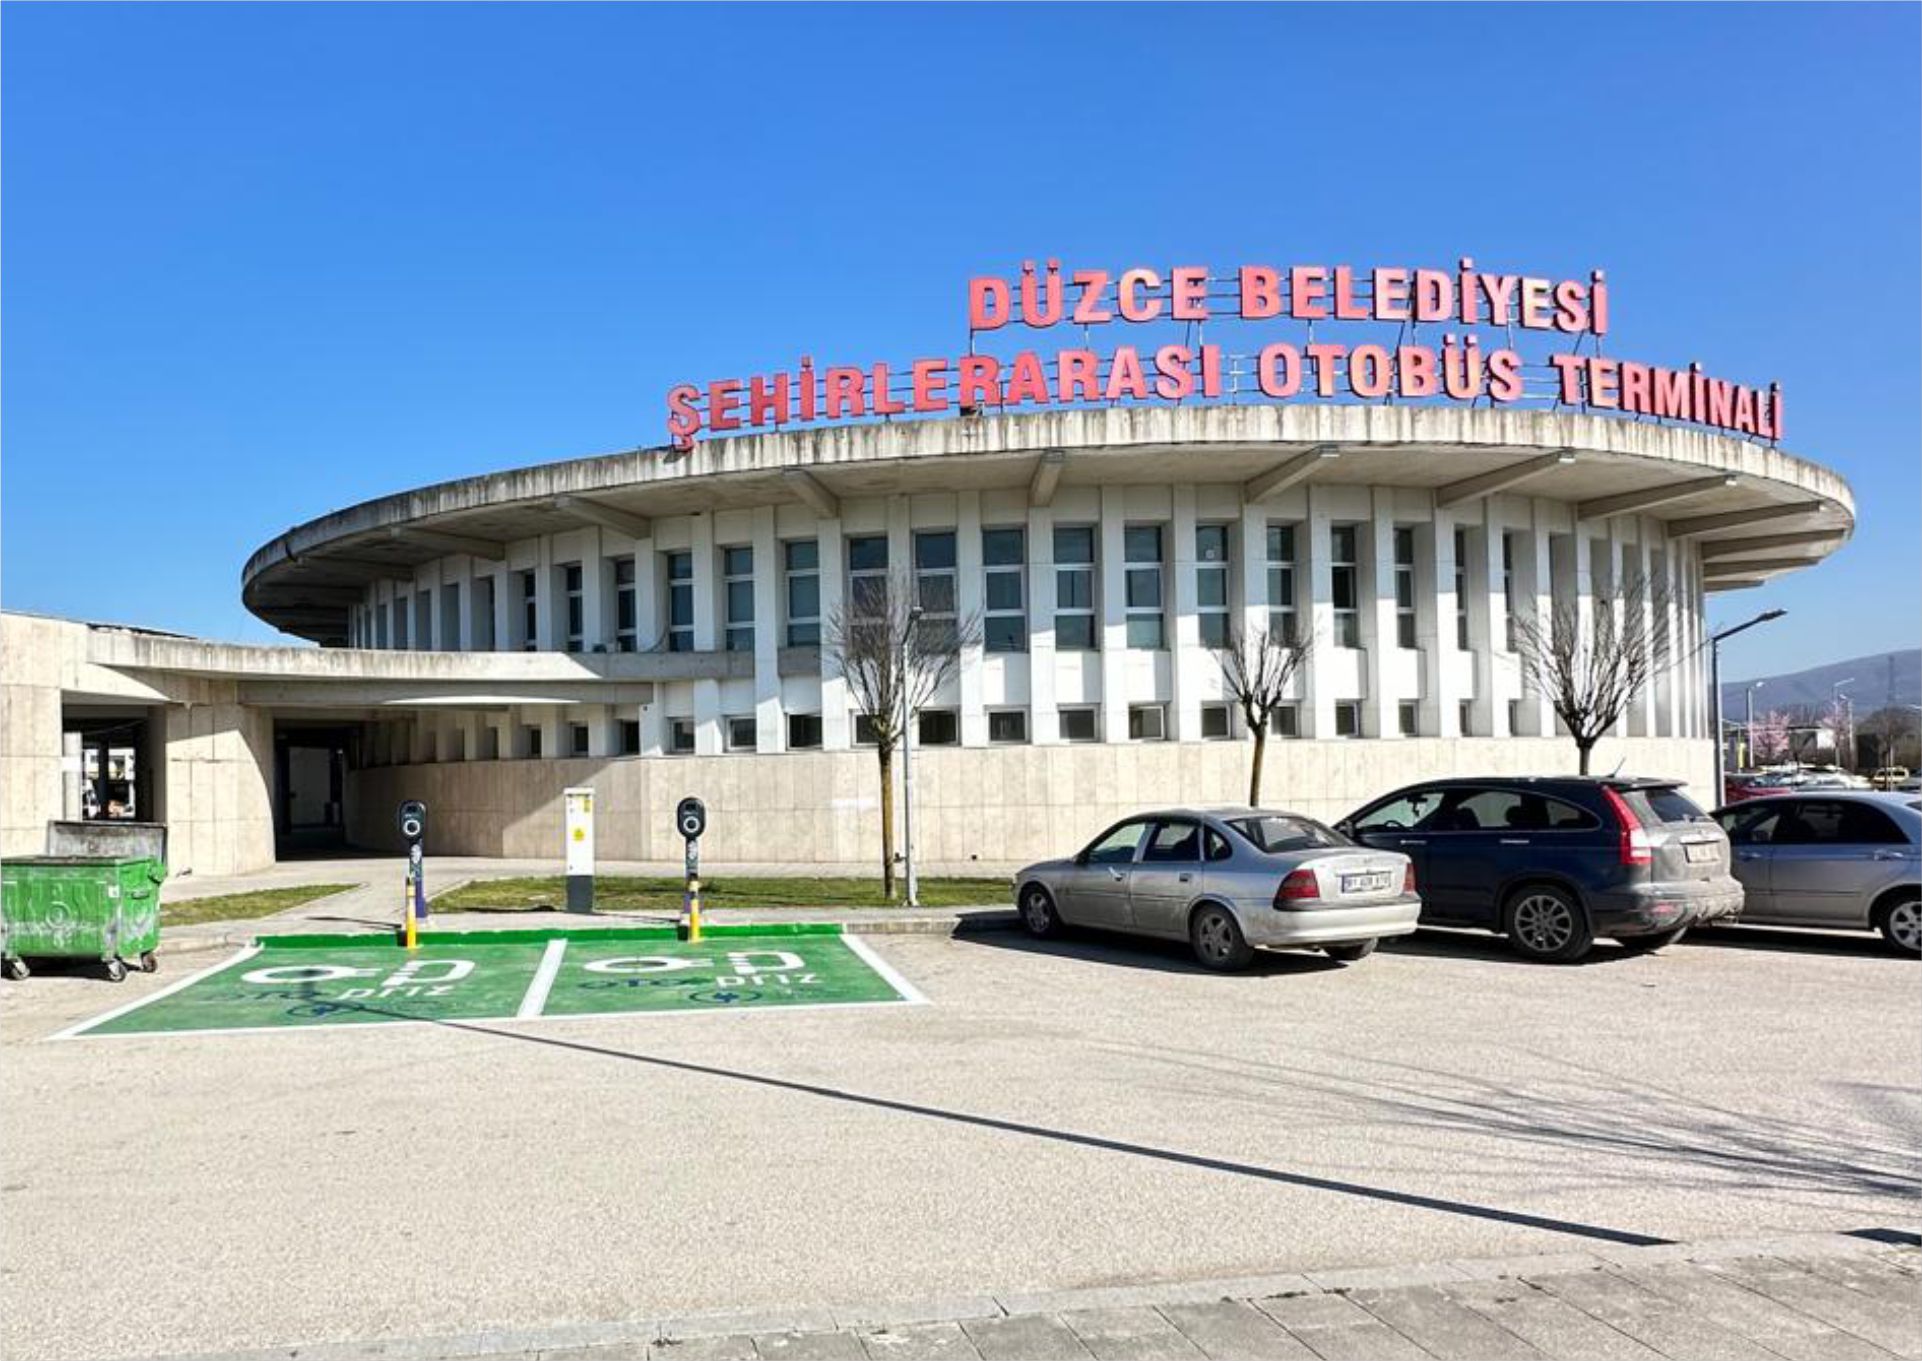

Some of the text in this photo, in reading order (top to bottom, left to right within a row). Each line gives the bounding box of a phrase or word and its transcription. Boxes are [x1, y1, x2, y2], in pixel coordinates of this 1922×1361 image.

[968, 258, 1608, 334] DÜZCE BELEDİYESİ
[667, 334, 1783, 453] ŞEHİRLERARASI OTOBÜS TERMİNALİ
